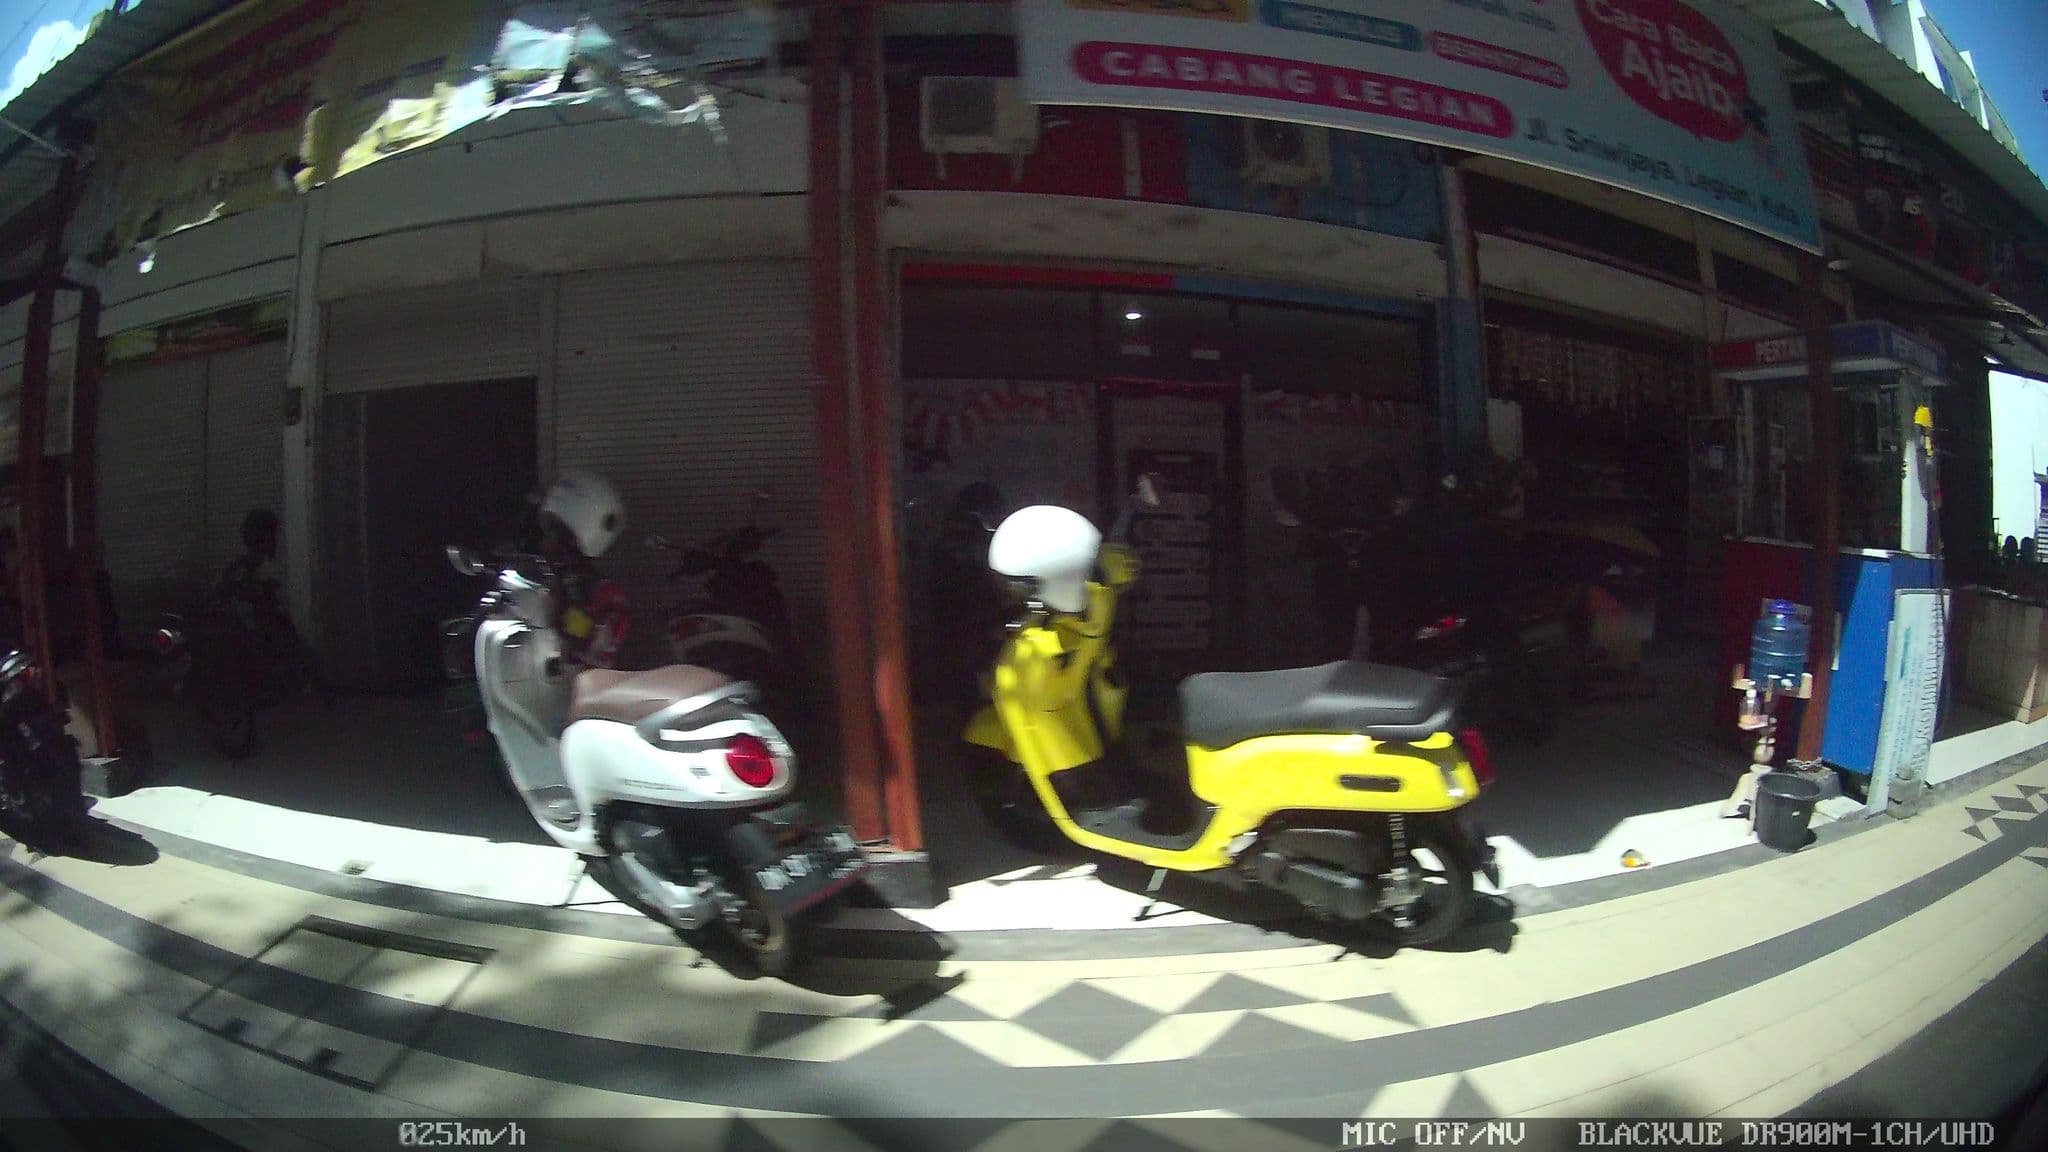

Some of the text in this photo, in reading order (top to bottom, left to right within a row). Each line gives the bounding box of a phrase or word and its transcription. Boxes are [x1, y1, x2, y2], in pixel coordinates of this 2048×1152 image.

[1585, 0, 1663, 42] Cara
[1666, 24, 1738, 76] Baca
[1621, 38, 1736, 115] Ajaib
[1103, 51, 1497, 128] CABANG LEGIAN
